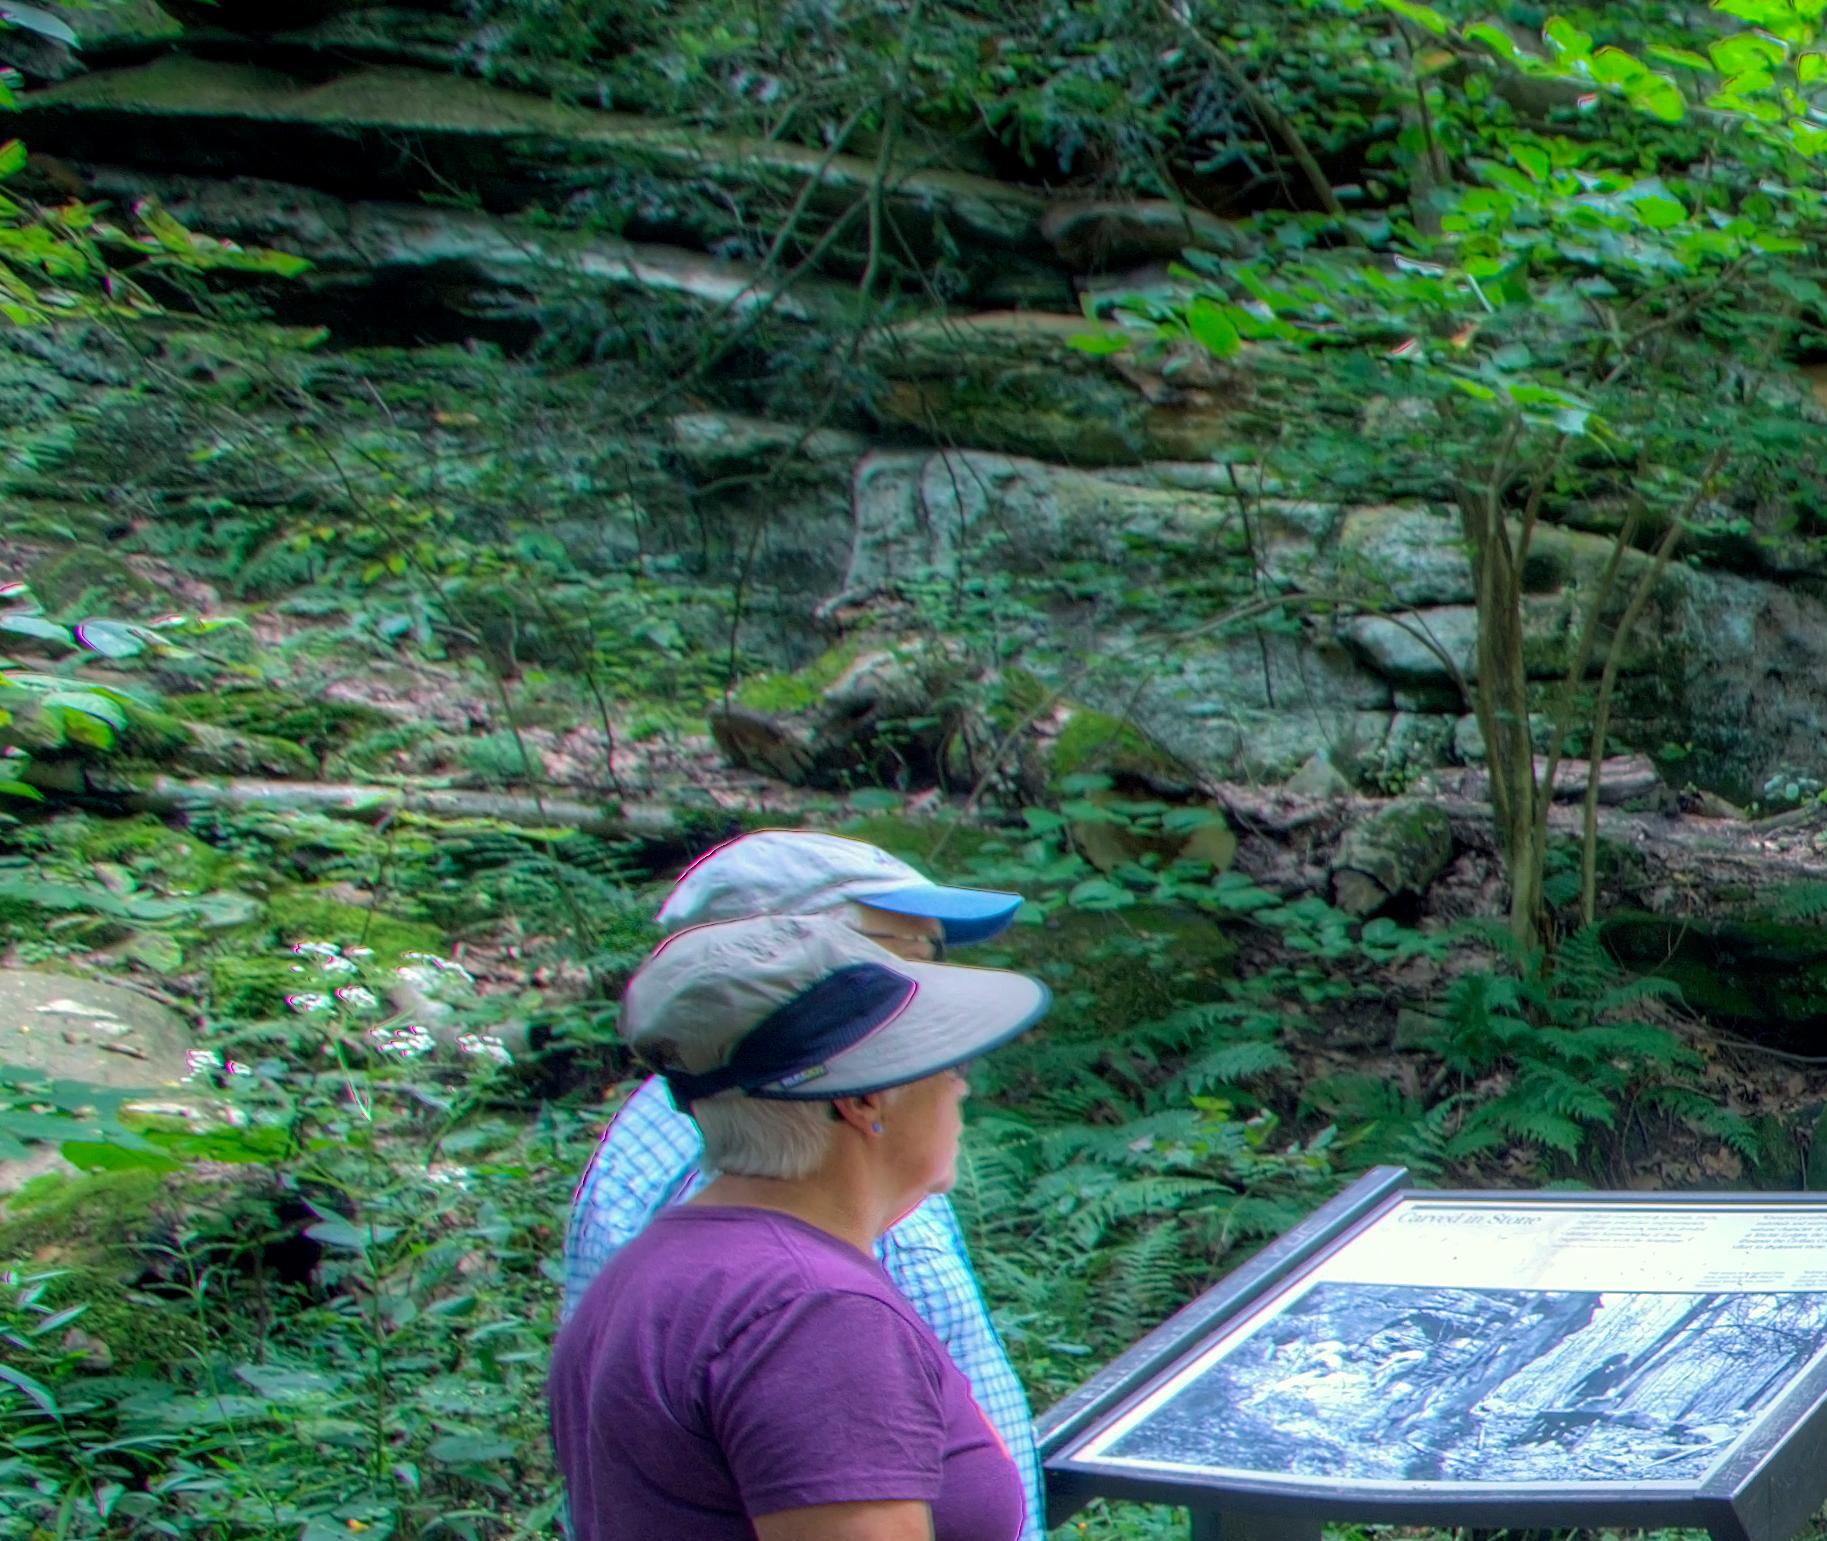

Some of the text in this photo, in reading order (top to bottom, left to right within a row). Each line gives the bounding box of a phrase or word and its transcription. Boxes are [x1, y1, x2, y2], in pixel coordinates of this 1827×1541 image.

[1398, 1212, 1543, 1225] Carved in Stone
